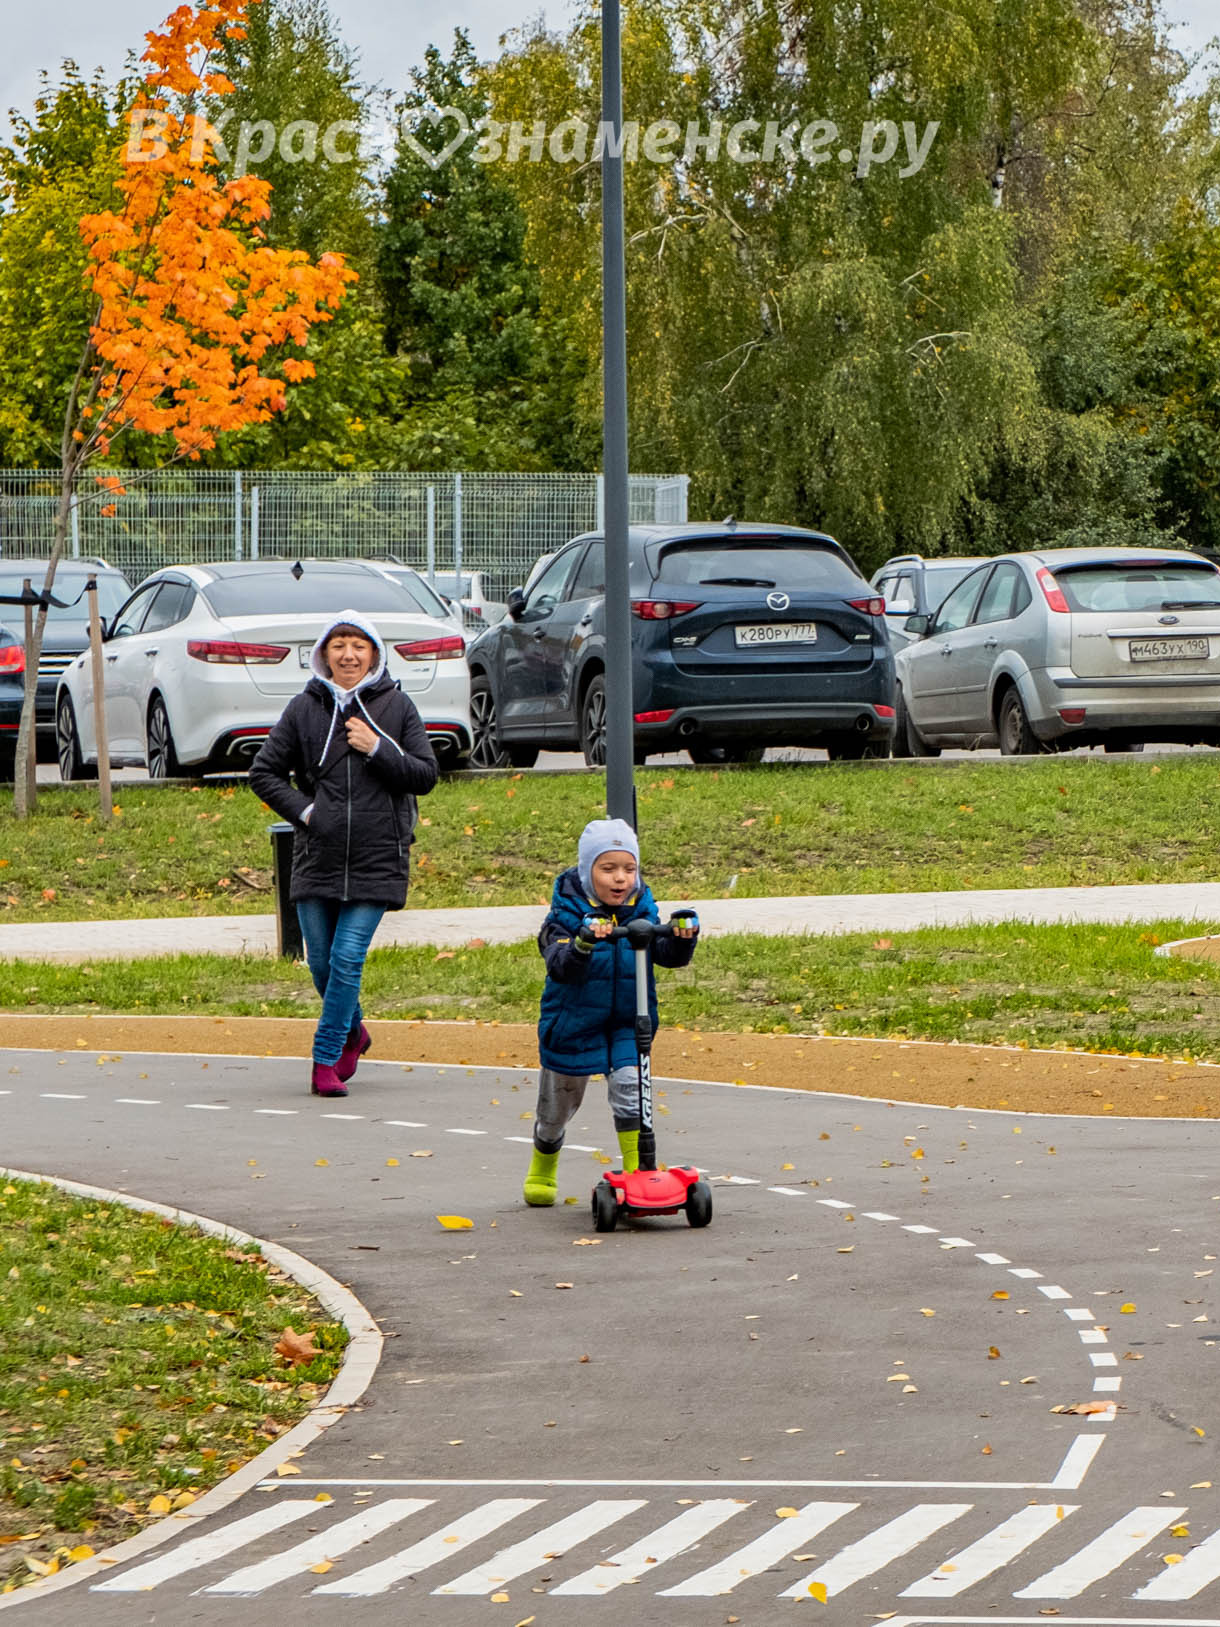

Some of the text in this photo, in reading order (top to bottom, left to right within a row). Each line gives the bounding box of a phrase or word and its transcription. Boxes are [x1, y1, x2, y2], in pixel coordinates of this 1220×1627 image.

[740, 626, 791, 642] К280РУ
[792, 624, 811, 635] 777
[1187, 640, 1204, 650] 190
[640, 1053, 652, 1128] KREISS
